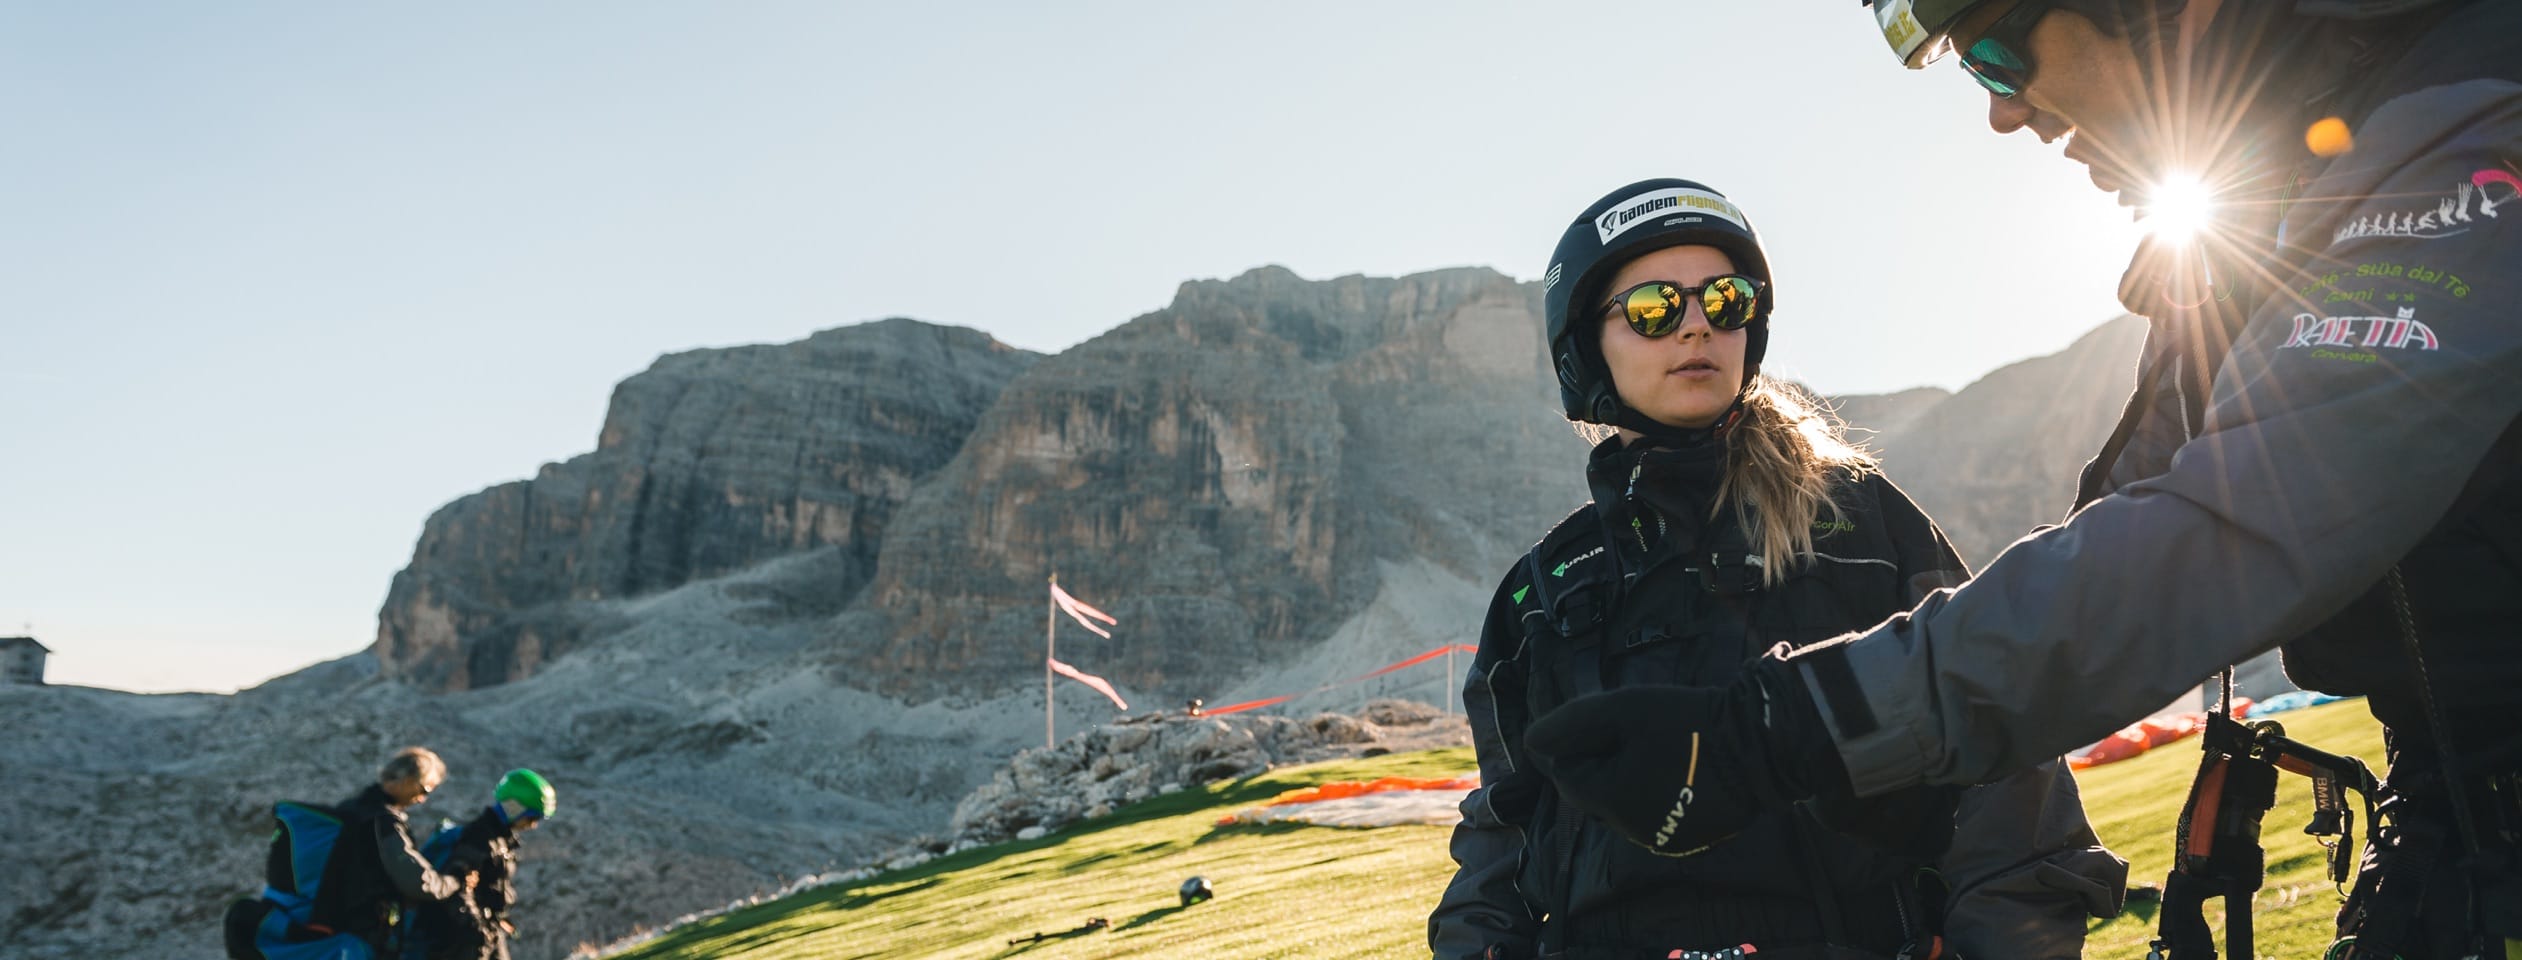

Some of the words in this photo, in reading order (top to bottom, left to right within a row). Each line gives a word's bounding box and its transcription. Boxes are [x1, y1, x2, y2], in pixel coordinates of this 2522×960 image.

[2408, 265, 2444, 284] dal
[2277, 310, 2438, 350] RAETIA
[2316, 777, 2330, 810] BMW
[1656, 787, 1693, 846] CAMP
